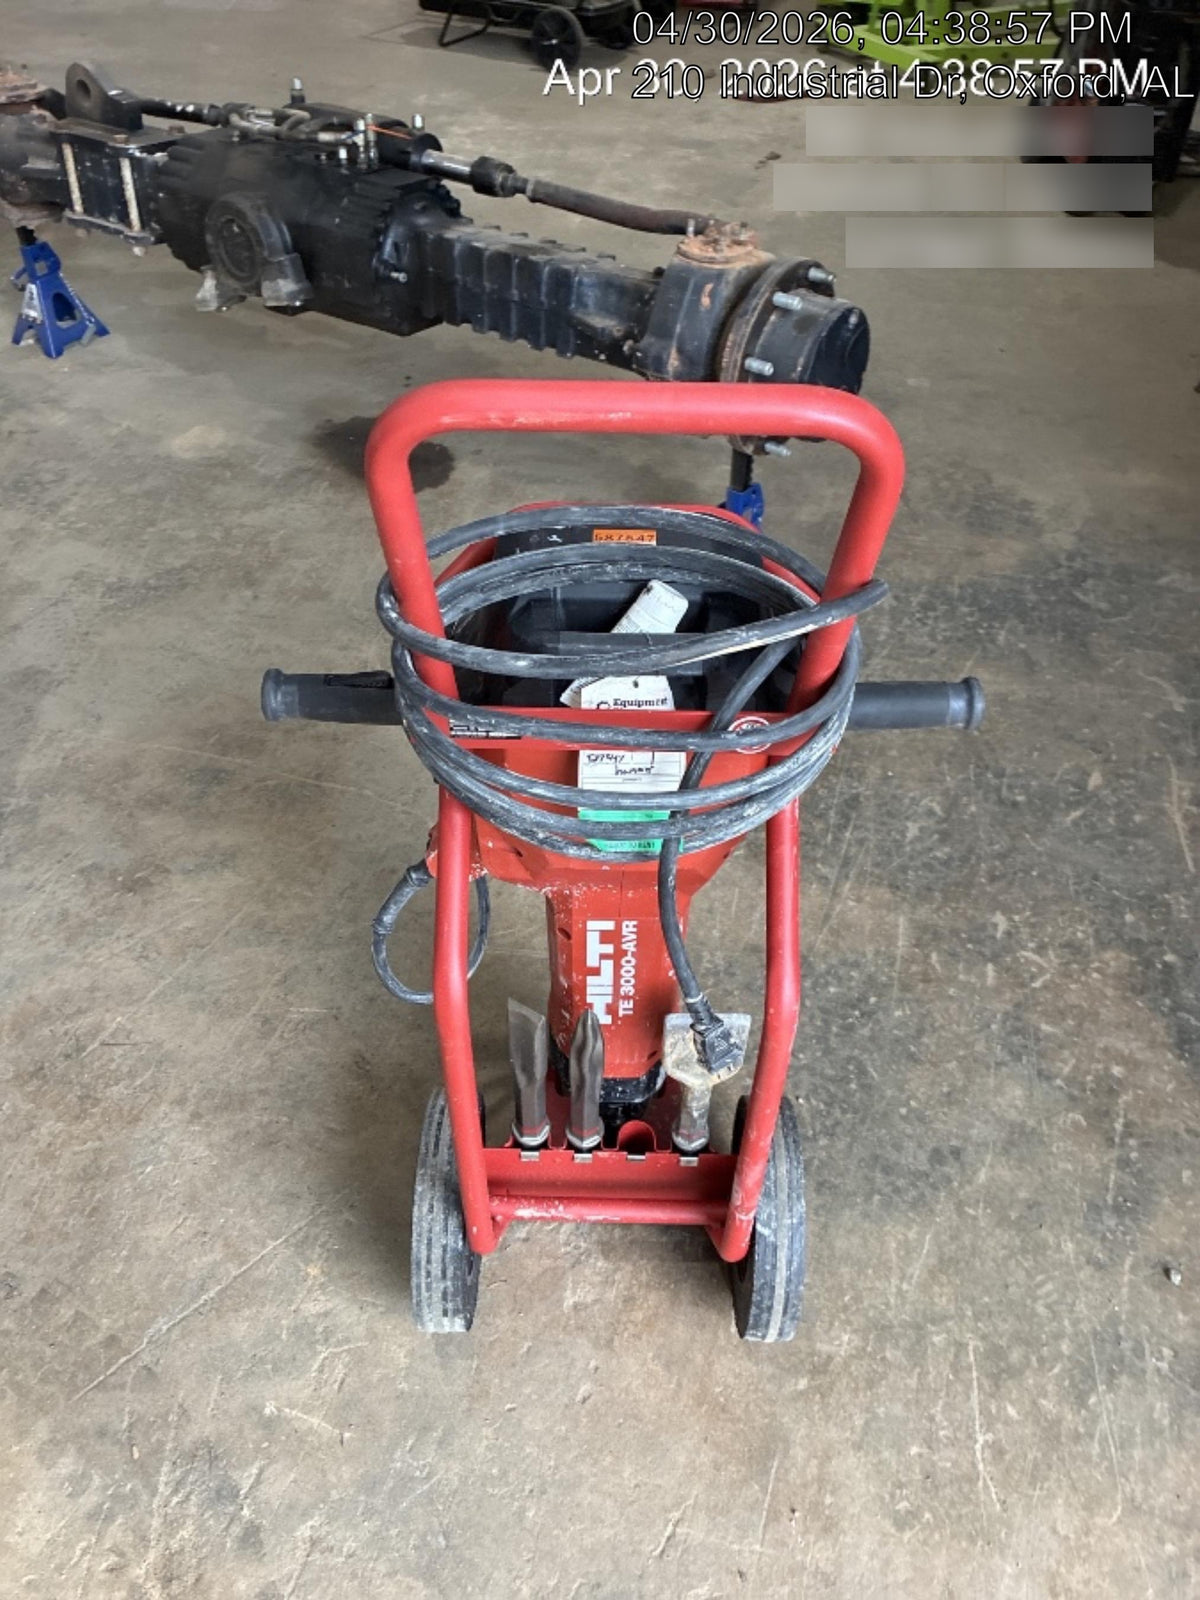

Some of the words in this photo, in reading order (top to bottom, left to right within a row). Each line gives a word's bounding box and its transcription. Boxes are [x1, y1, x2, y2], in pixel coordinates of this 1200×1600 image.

[586, 920, 616, 1025] HILTI
[619, 920, 639, 997] 3000-AVR
[618, 999, 634, 1018] TE
